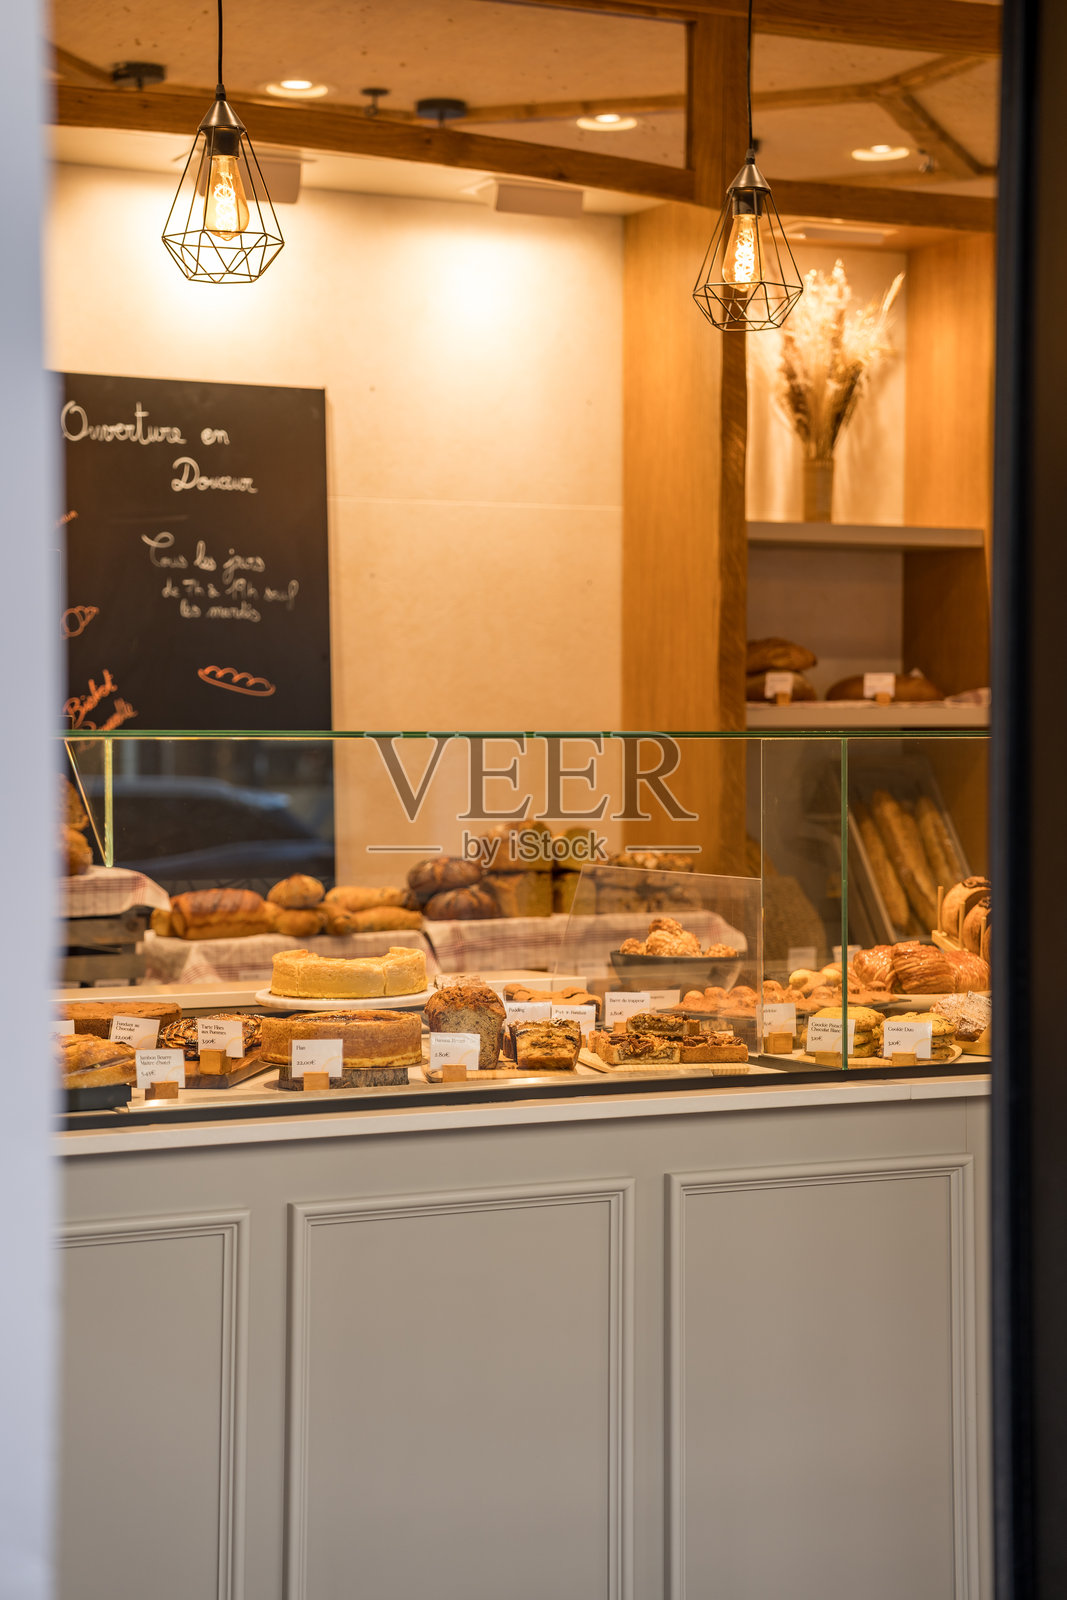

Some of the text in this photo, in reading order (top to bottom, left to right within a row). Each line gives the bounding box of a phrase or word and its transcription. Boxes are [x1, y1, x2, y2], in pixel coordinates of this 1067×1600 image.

[61, 400, 230, 445] Ouverture en
[193, 540, 217, 572] les
